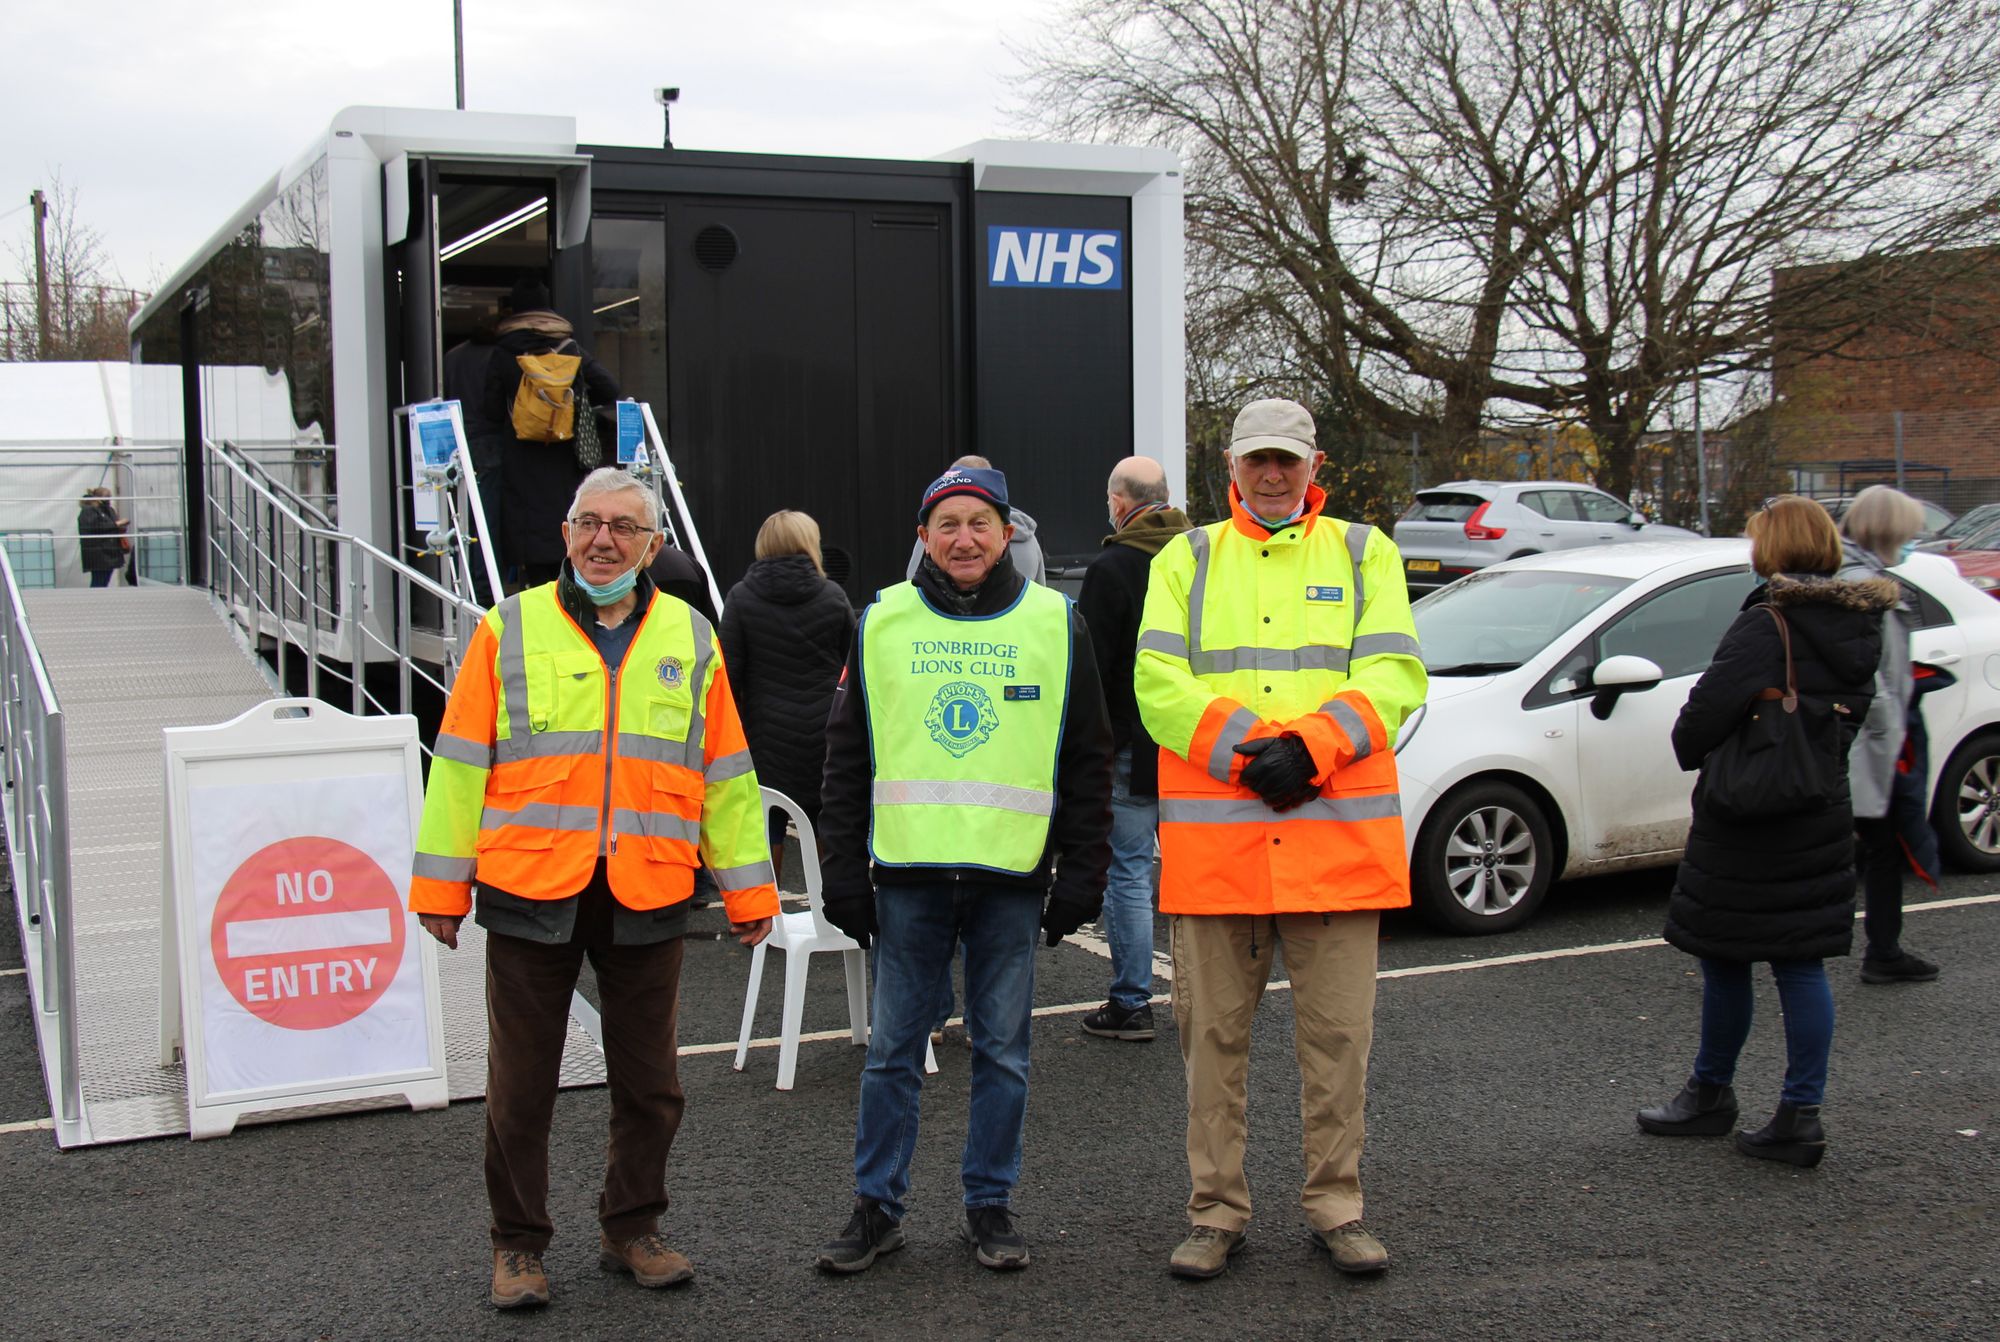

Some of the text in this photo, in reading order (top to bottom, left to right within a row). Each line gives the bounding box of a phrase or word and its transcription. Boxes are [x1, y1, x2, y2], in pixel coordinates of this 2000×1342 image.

[992, 231, 1117, 285] NHS
[912, 641, 1018, 659] TONBRIDGE
[666, 667, 674, 679] L
[911, 660, 1017, 678] LIONS CLUB
[943, 686, 982, 701] LIONS
[951, 704, 970, 731] L
[938, 734, 980, 749] INTERNATIONAL
[276, 870, 334, 905] NO
[245, 957, 378, 1002] ENTRY
